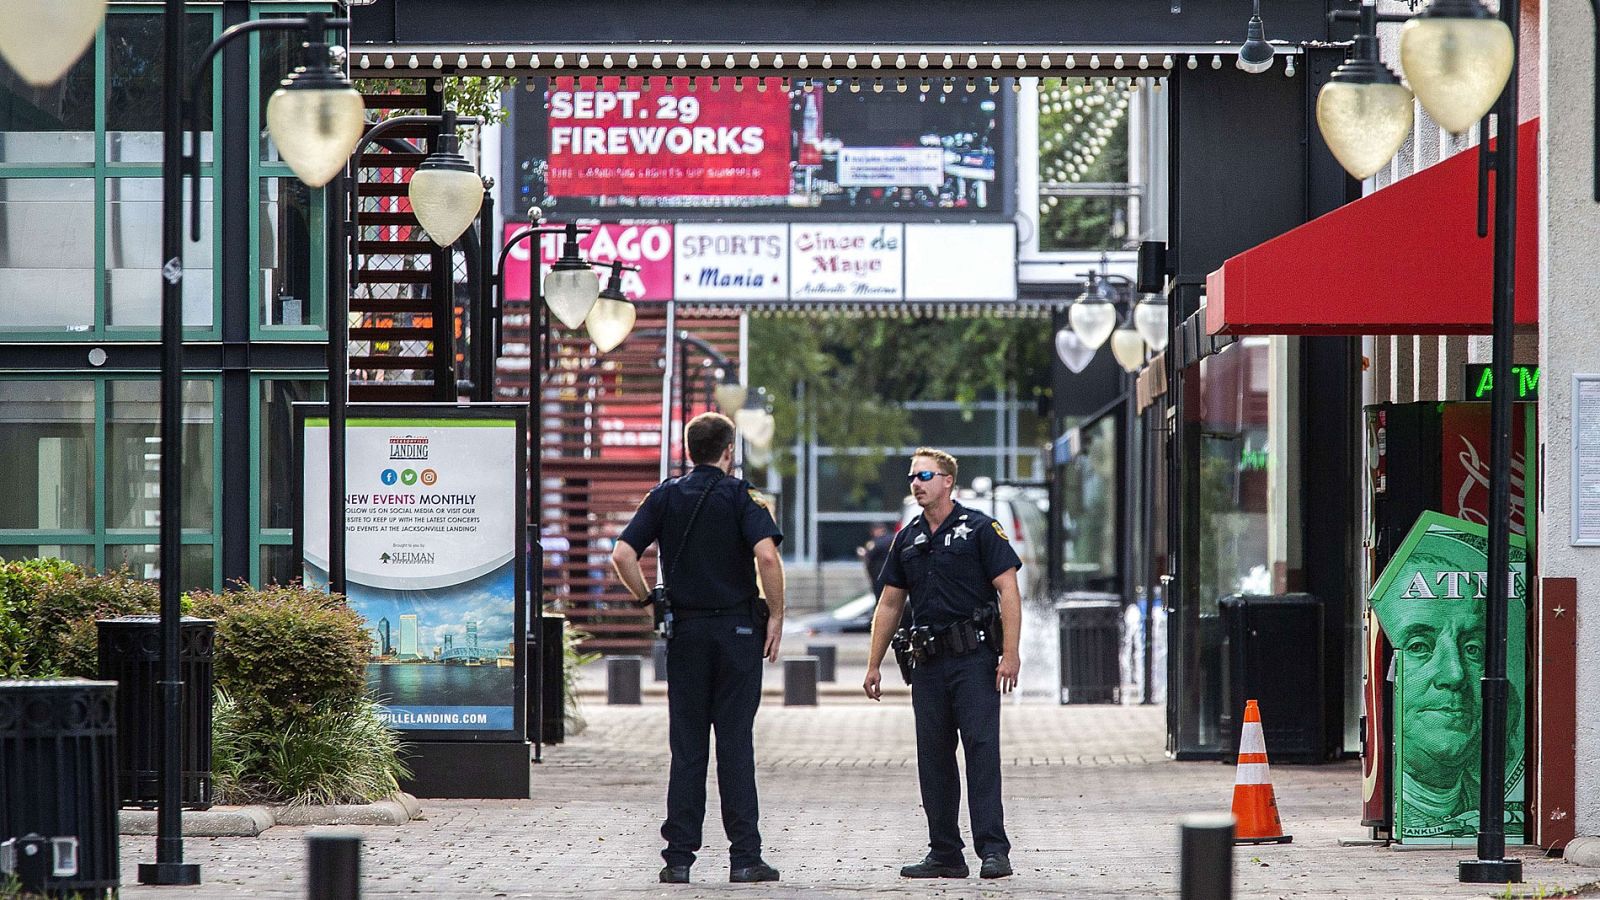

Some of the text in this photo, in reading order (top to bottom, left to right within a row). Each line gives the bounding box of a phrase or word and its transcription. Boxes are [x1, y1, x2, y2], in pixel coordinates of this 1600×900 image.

[550, 91, 700, 124] SEPT. 29
[551, 126, 765, 155] FIREWORKS
[682, 235, 781, 259] SPORTS
[795, 226, 899, 251] Cinco de
[812, 255, 882, 276] Mayo
[698, 268, 764, 287] Mania
[1475, 367, 1540, 398] AM
[390, 444, 429, 457] LANDING
[373, 494, 416, 505] EVENTS
[419, 494, 477, 505] MONTHLY
[392, 552, 435, 561] SLEIMAN
[1402, 826, 1444, 835] RANKLIN
